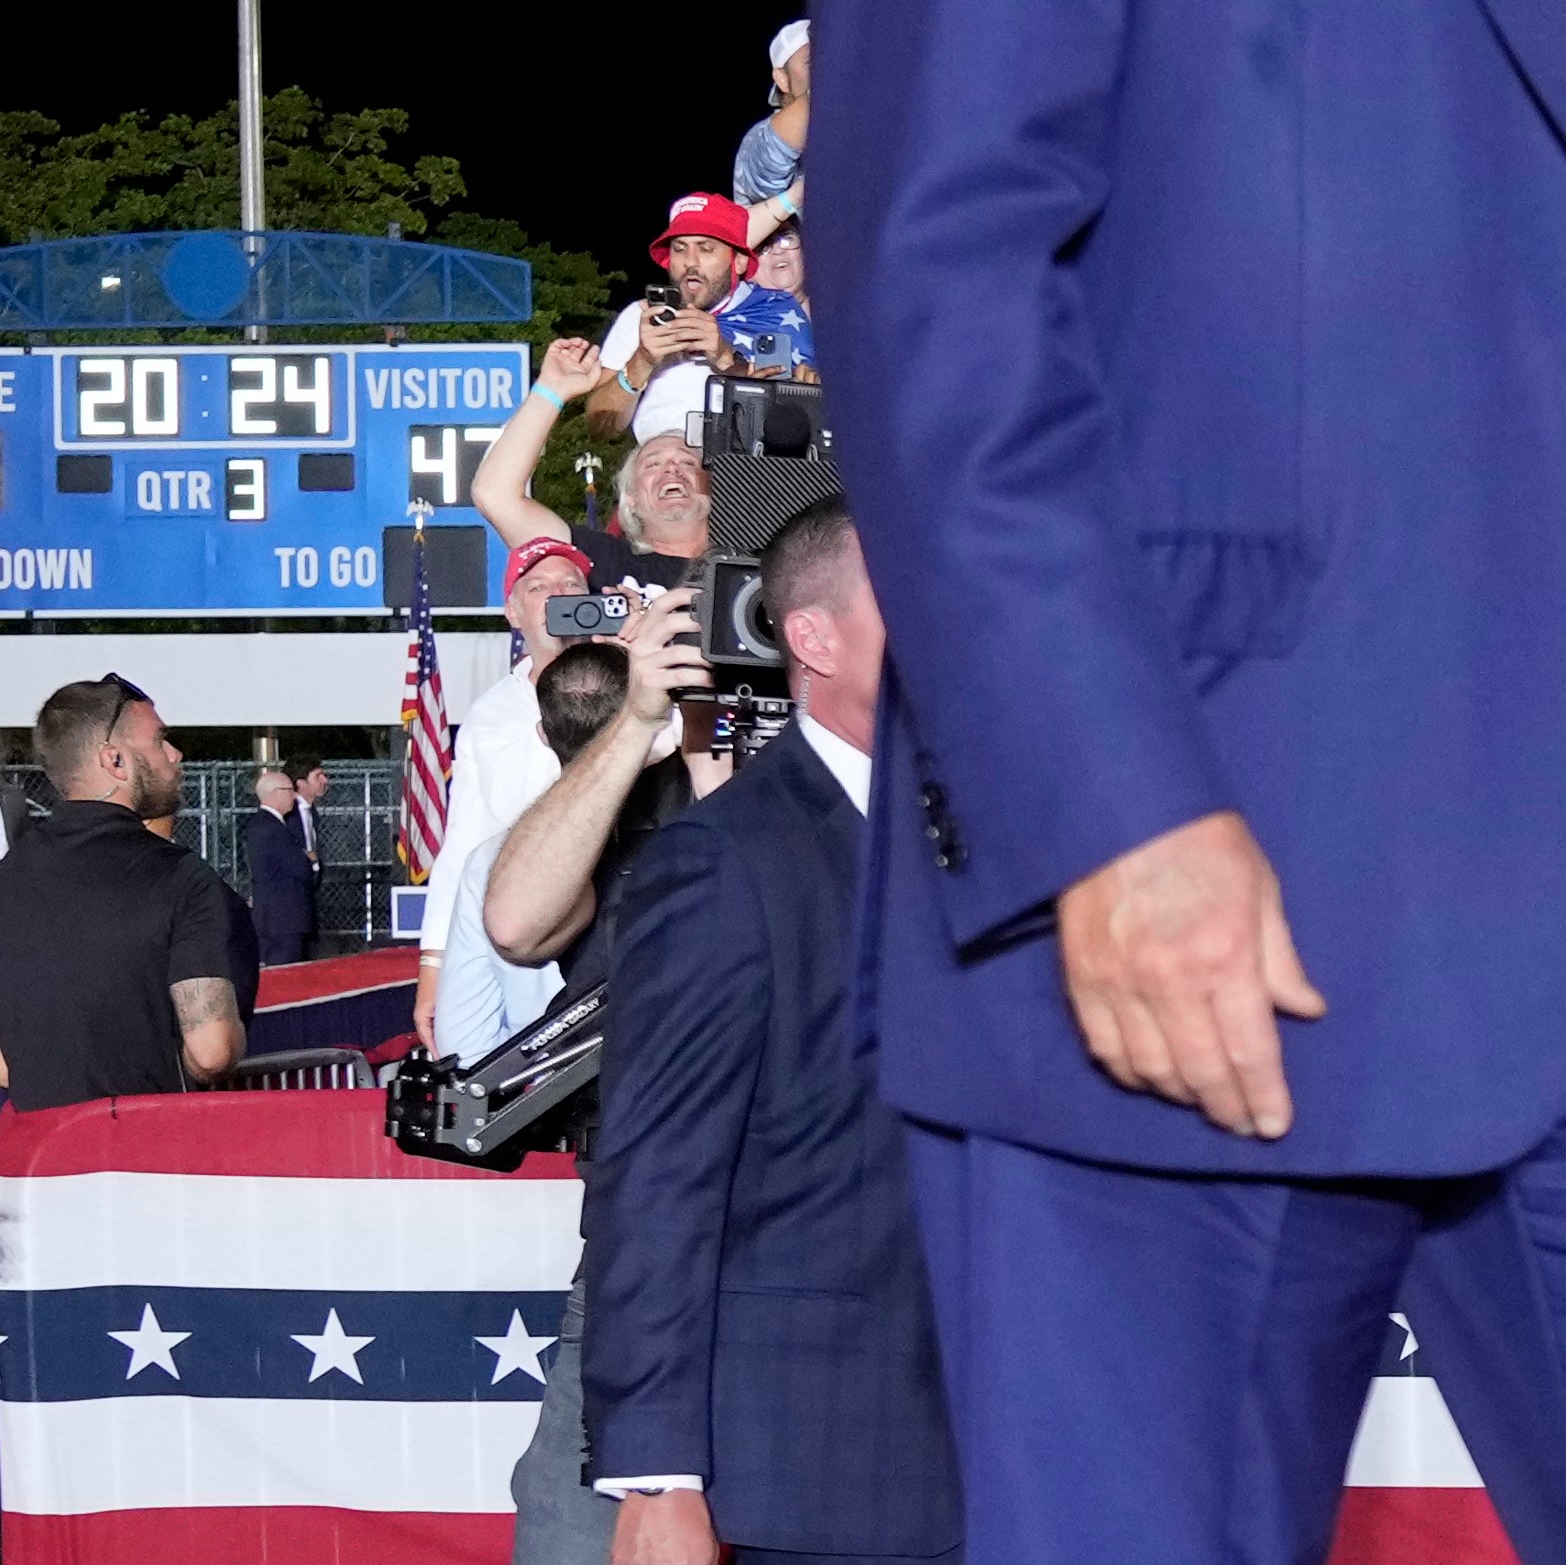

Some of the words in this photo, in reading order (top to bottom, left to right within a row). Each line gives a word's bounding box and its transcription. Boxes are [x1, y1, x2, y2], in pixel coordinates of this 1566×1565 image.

[364, 367, 514, 410] VISITOR
[136, 470, 213, 512] QTR
[229, 458, 266, 520] 3
[0, 547, 93, 591] DOWN
[274, 546, 318, 589] TO
[330, 545, 377, 588] GO
